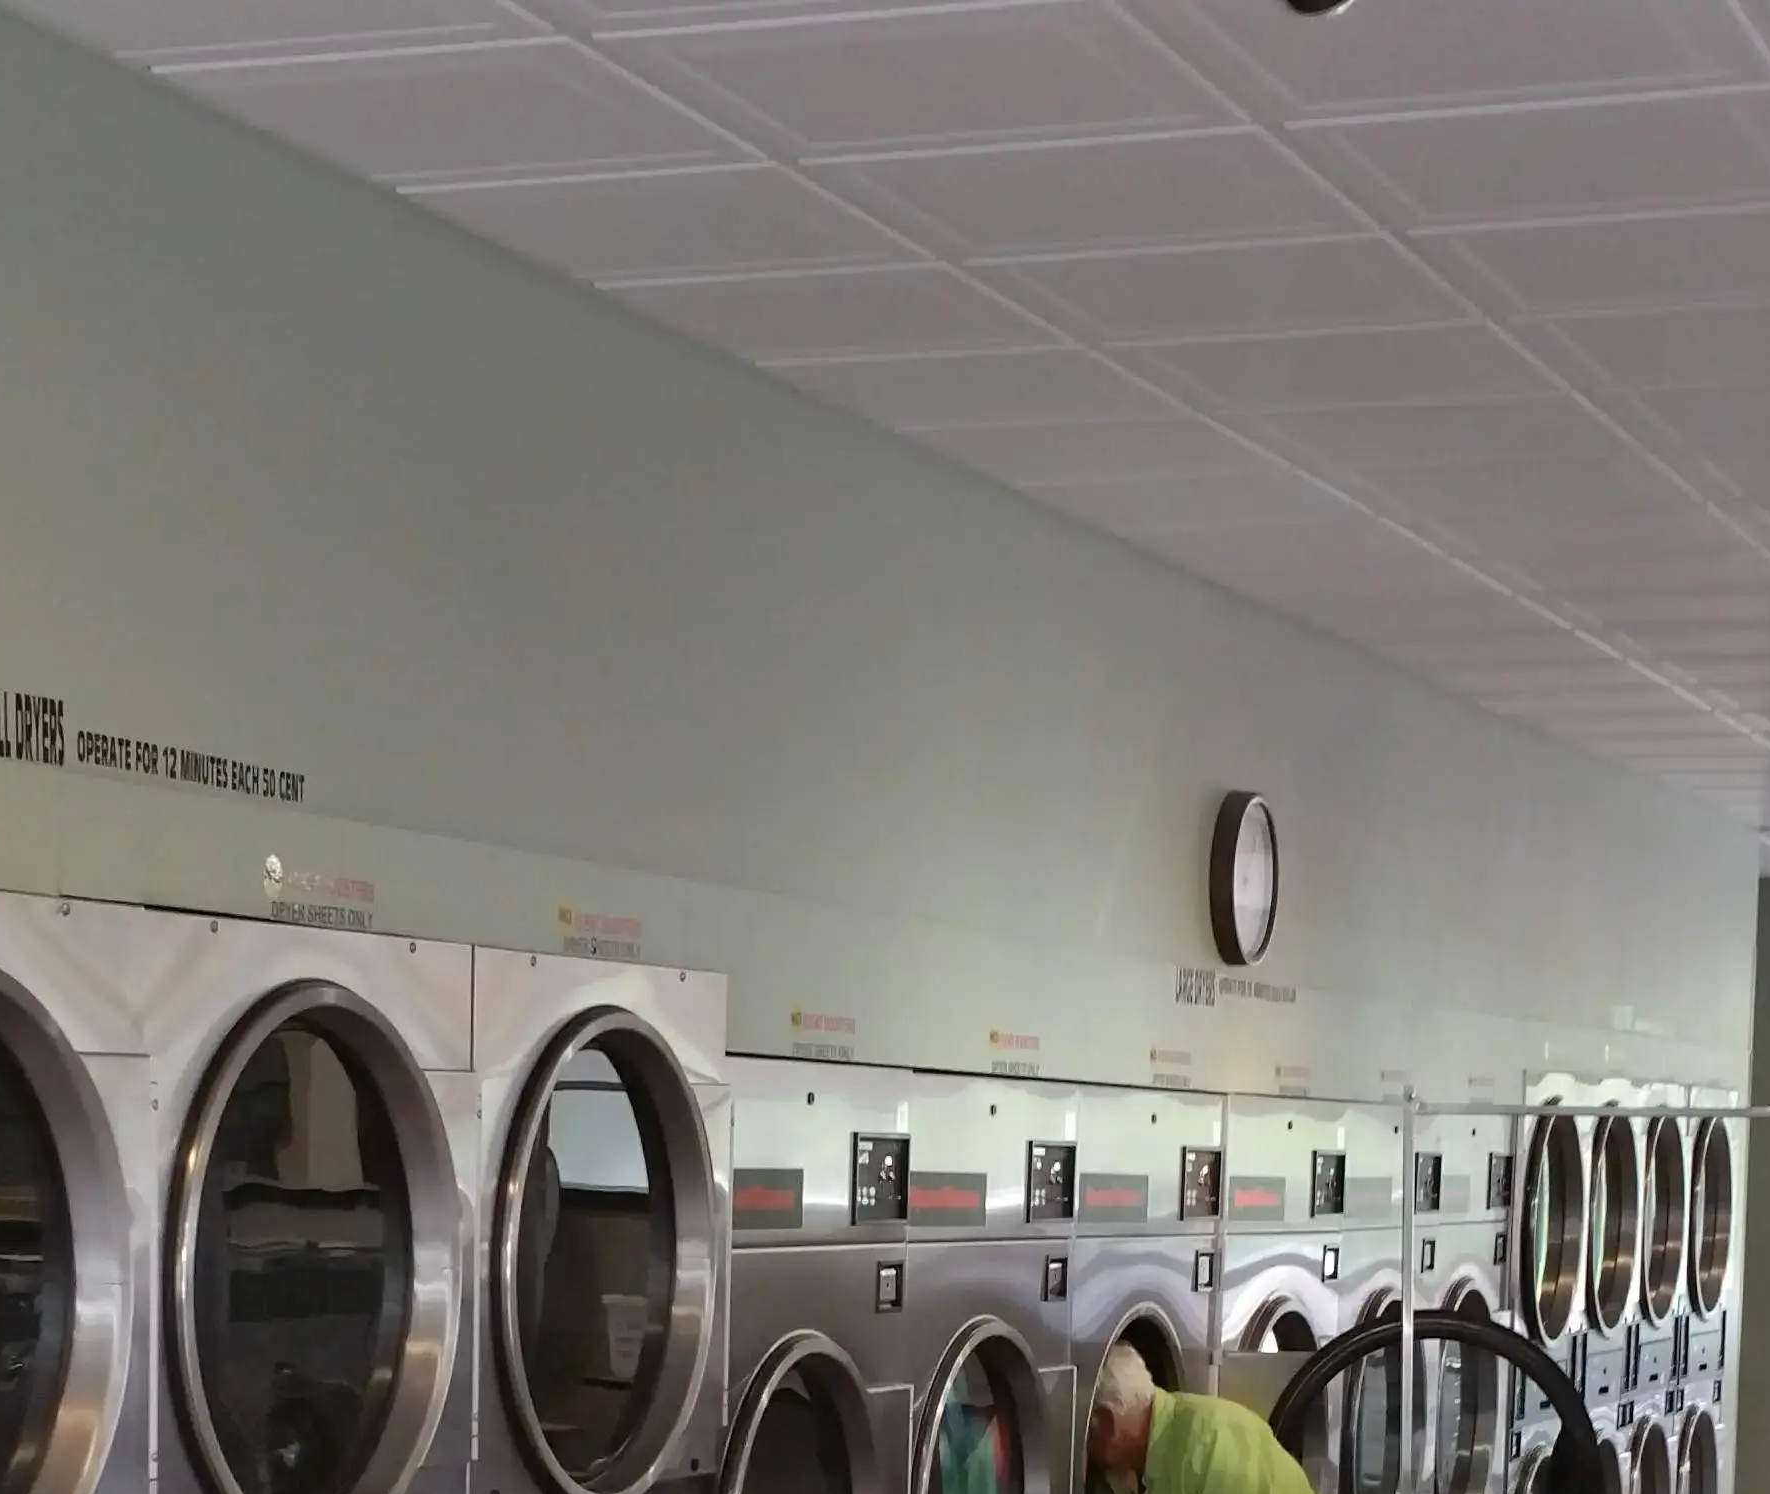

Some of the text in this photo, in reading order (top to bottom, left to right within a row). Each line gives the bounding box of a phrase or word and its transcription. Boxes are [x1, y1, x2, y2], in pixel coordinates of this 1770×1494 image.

[15, 692, 65, 767] DRYERS
[77, 729, 132, 771] OPERATE
[135, 740, 159, 775] FOR
[162, 746, 177, 779] 12
[180, 749, 228, 788] MINUTES
[231, 759, 260, 795] EACH
[262, 767, 276, 798] 50
[279, 771, 305, 802] CENT
